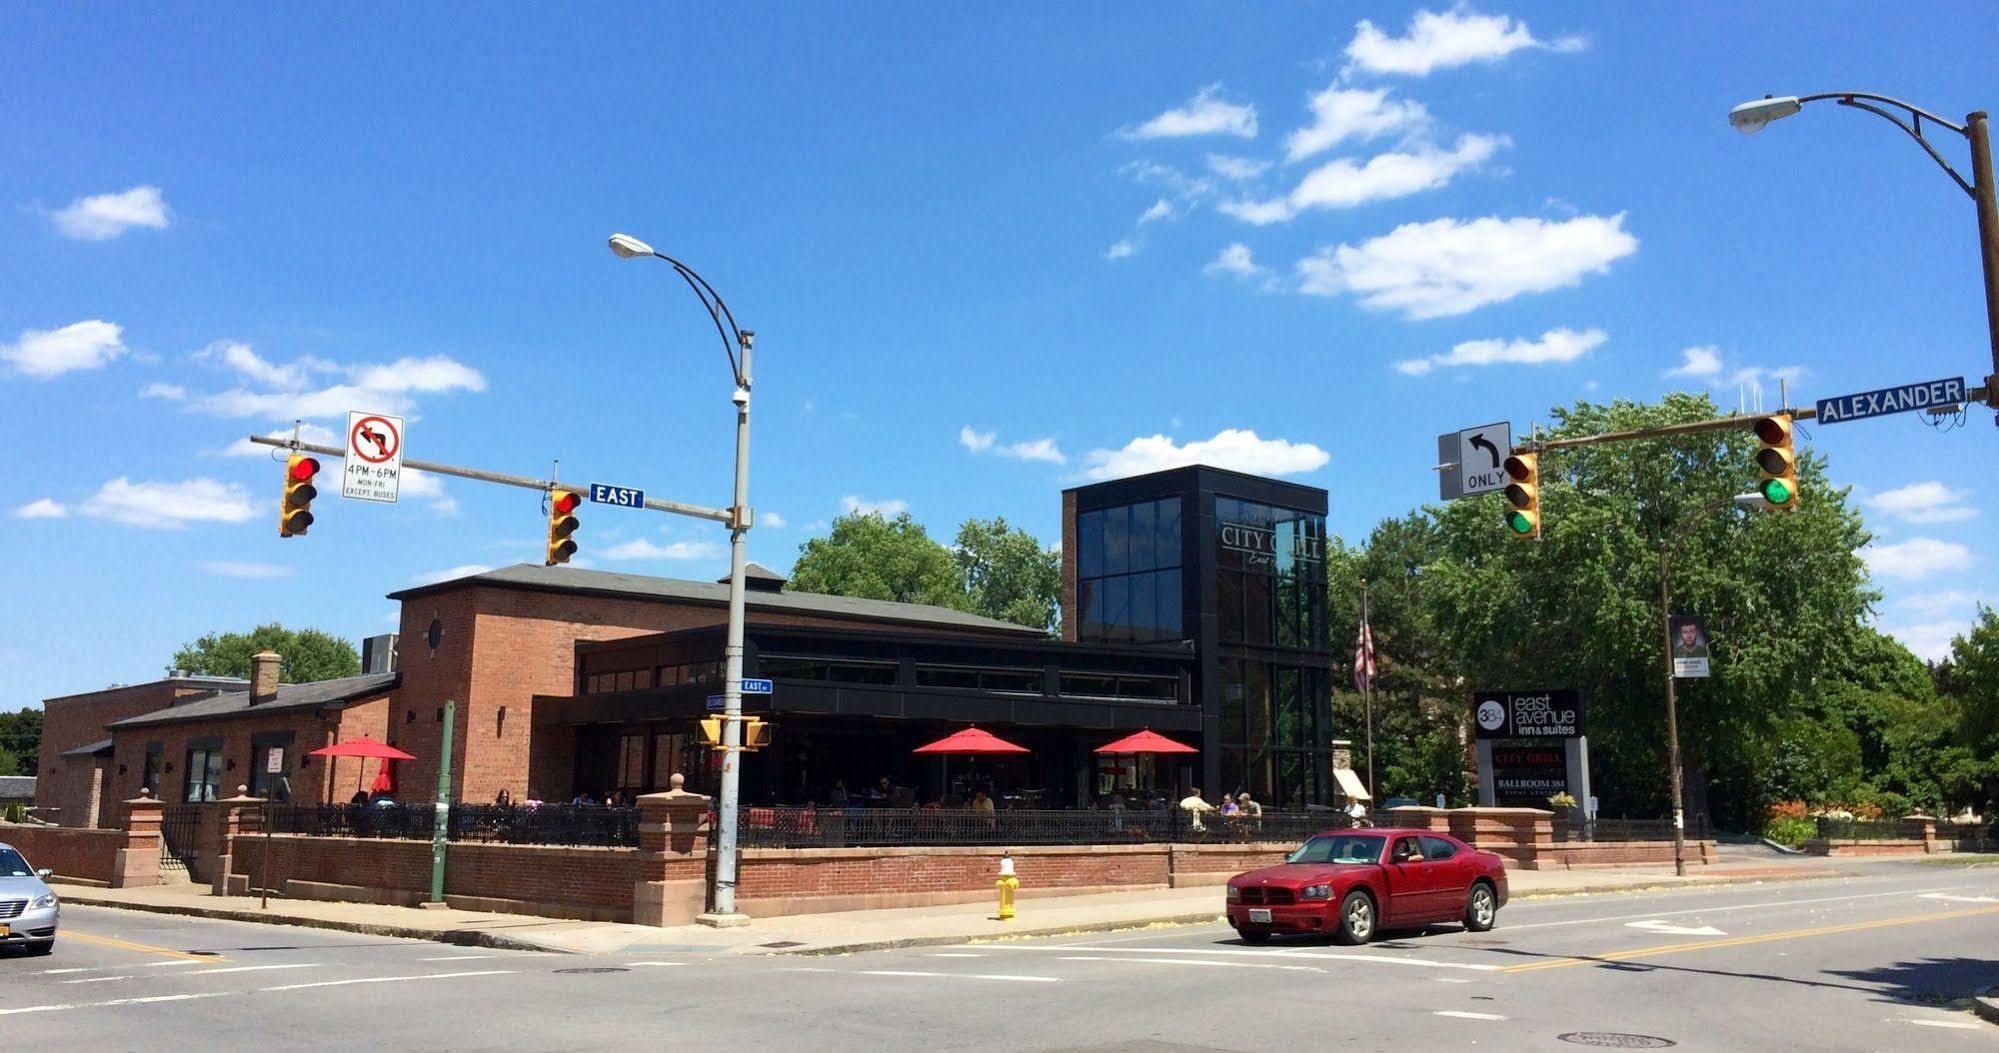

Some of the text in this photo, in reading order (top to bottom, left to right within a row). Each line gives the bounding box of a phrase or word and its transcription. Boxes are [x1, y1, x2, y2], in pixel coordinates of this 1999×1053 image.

[1822, 381, 1961, 422] ALEXANDER
[357, 479, 385, 489] MON-FRI
[1468, 471, 1505, 489] ONLY
[345, 487, 395, 500] EXCEPT BUSES
[596, 486, 638, 506] EAST
[1221, 526, 1263, 550] CITY
[744, 681, 762, 691] EAST
[1514, 693, 1551, 711] east
[1479, 708, 1503, 723] 384
[1515, 709, 1576, 725] avenue
[1498, 779, 1550, 789] BALLROOM
